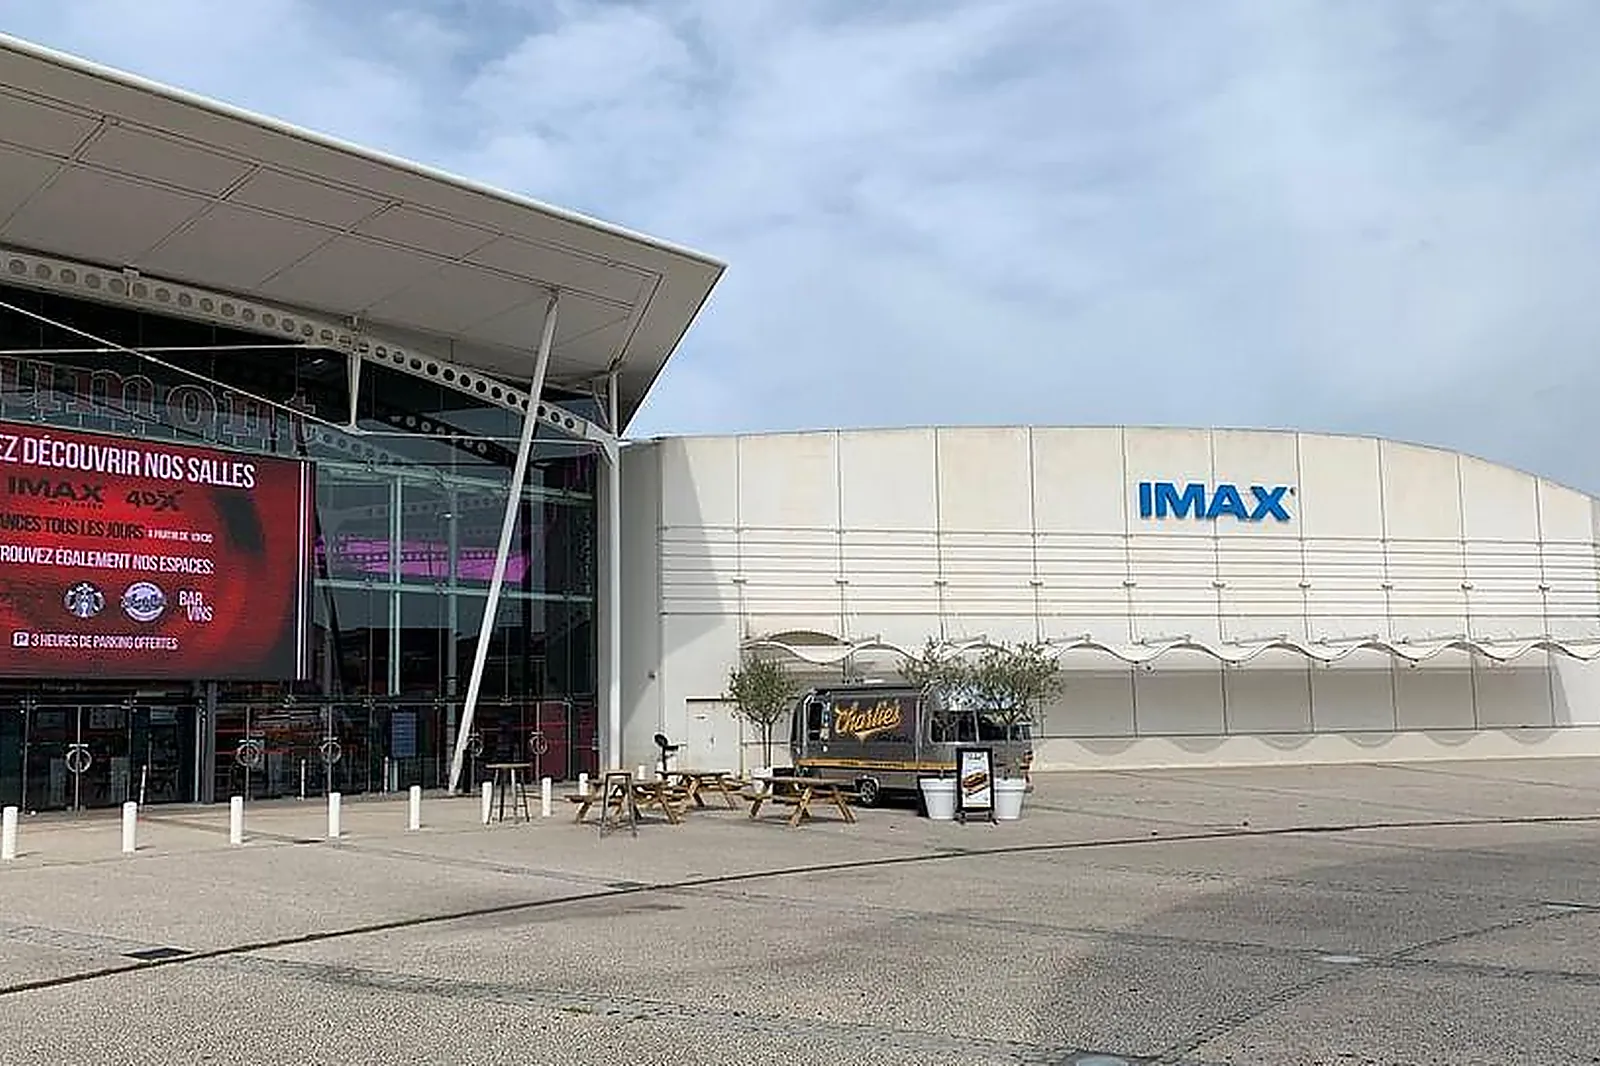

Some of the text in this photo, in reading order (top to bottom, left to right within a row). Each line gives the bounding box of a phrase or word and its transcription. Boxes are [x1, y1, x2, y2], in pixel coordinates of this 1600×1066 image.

[23, 434, 141, 477] DÉCOUVRIR
[145, 452, 183, 480] NOS
[187, 457, 255, 489] SALLES
[8, 476, 104, 503] IMAX
[1139, 482, 1290, 522] IMAX
[43, 517, 79, 536] TOUS
[55, 547, 131, 569] ÉGALEMENT
[133, 554, 158, 571] NOS
[179, 590, 203, 607] BAR
[40, 634, 78, 648] HEURES
[79, 635, 92, 648] DE
[93, 635, 133, 650] PARKING
[134, 637, 178, 650] OFFERTES
